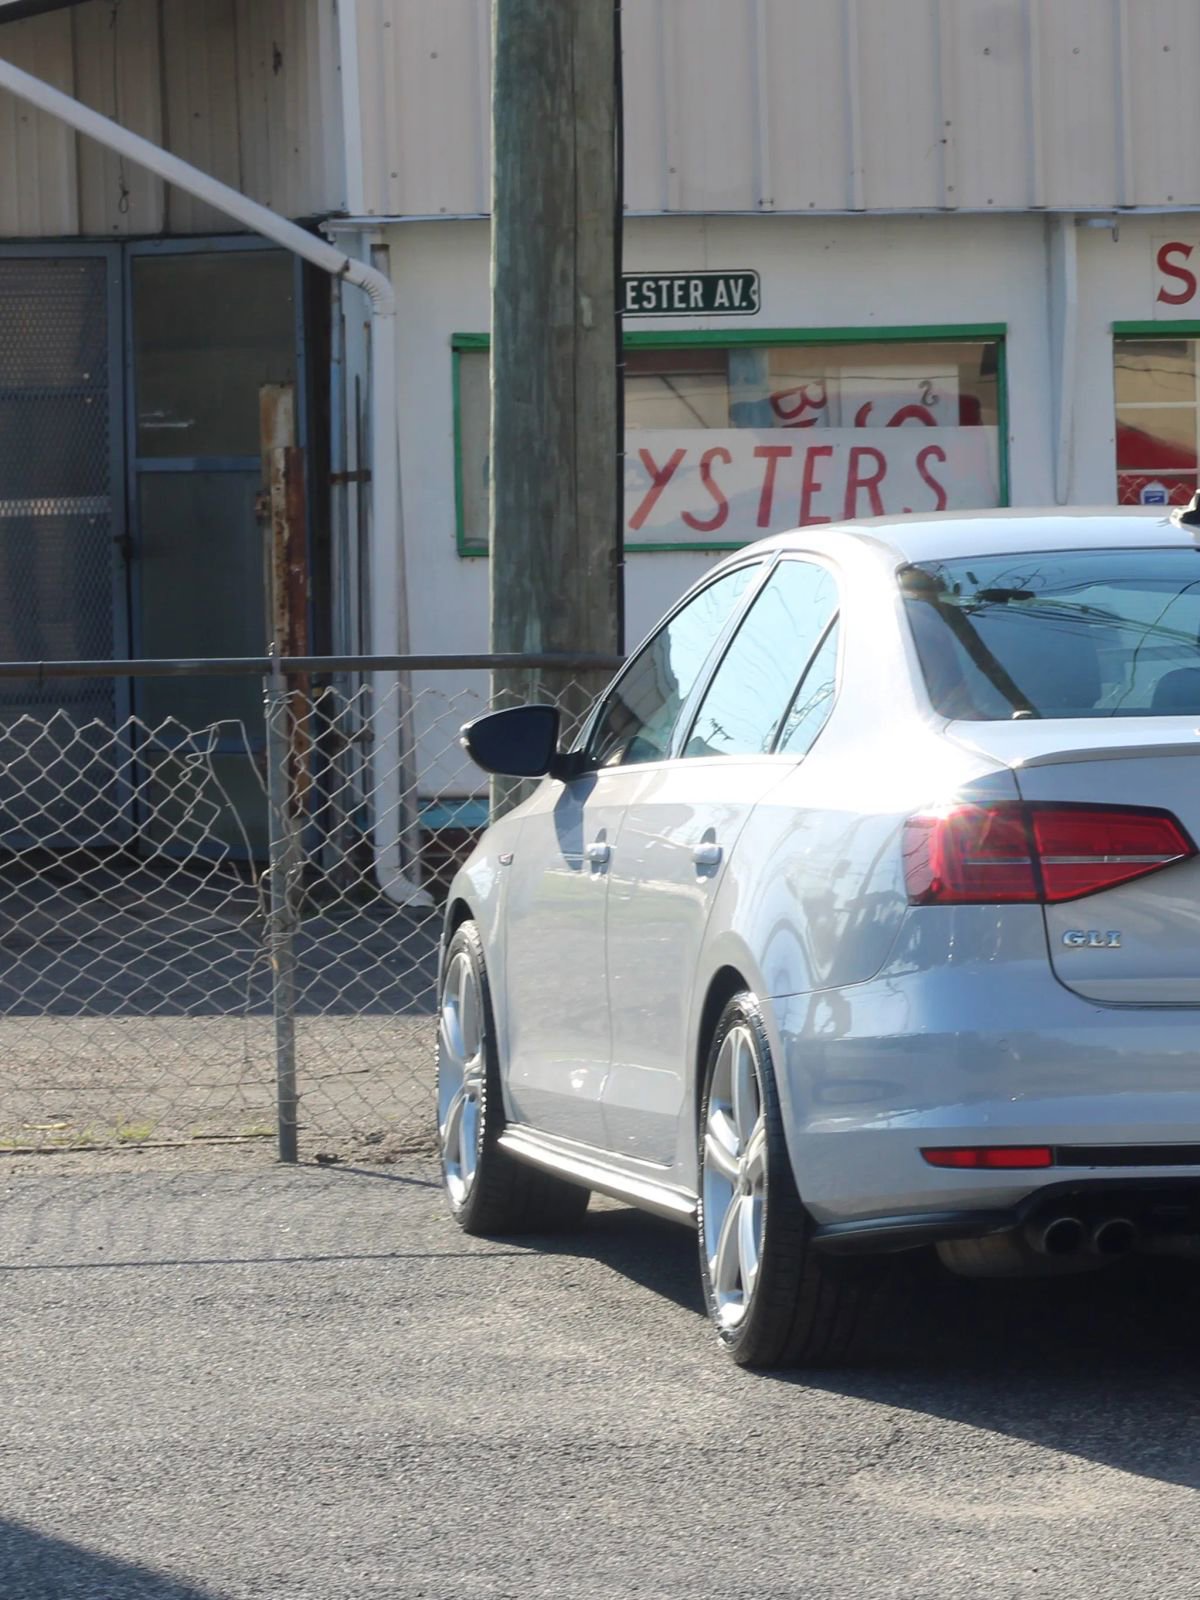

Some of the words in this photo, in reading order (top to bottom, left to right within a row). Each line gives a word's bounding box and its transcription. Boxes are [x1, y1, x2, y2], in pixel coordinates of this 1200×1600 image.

[626, 280, 704, 309] ESTER
[713, 278, 748, 307] AV.
[1062, 930, 1122, 948] GLI
